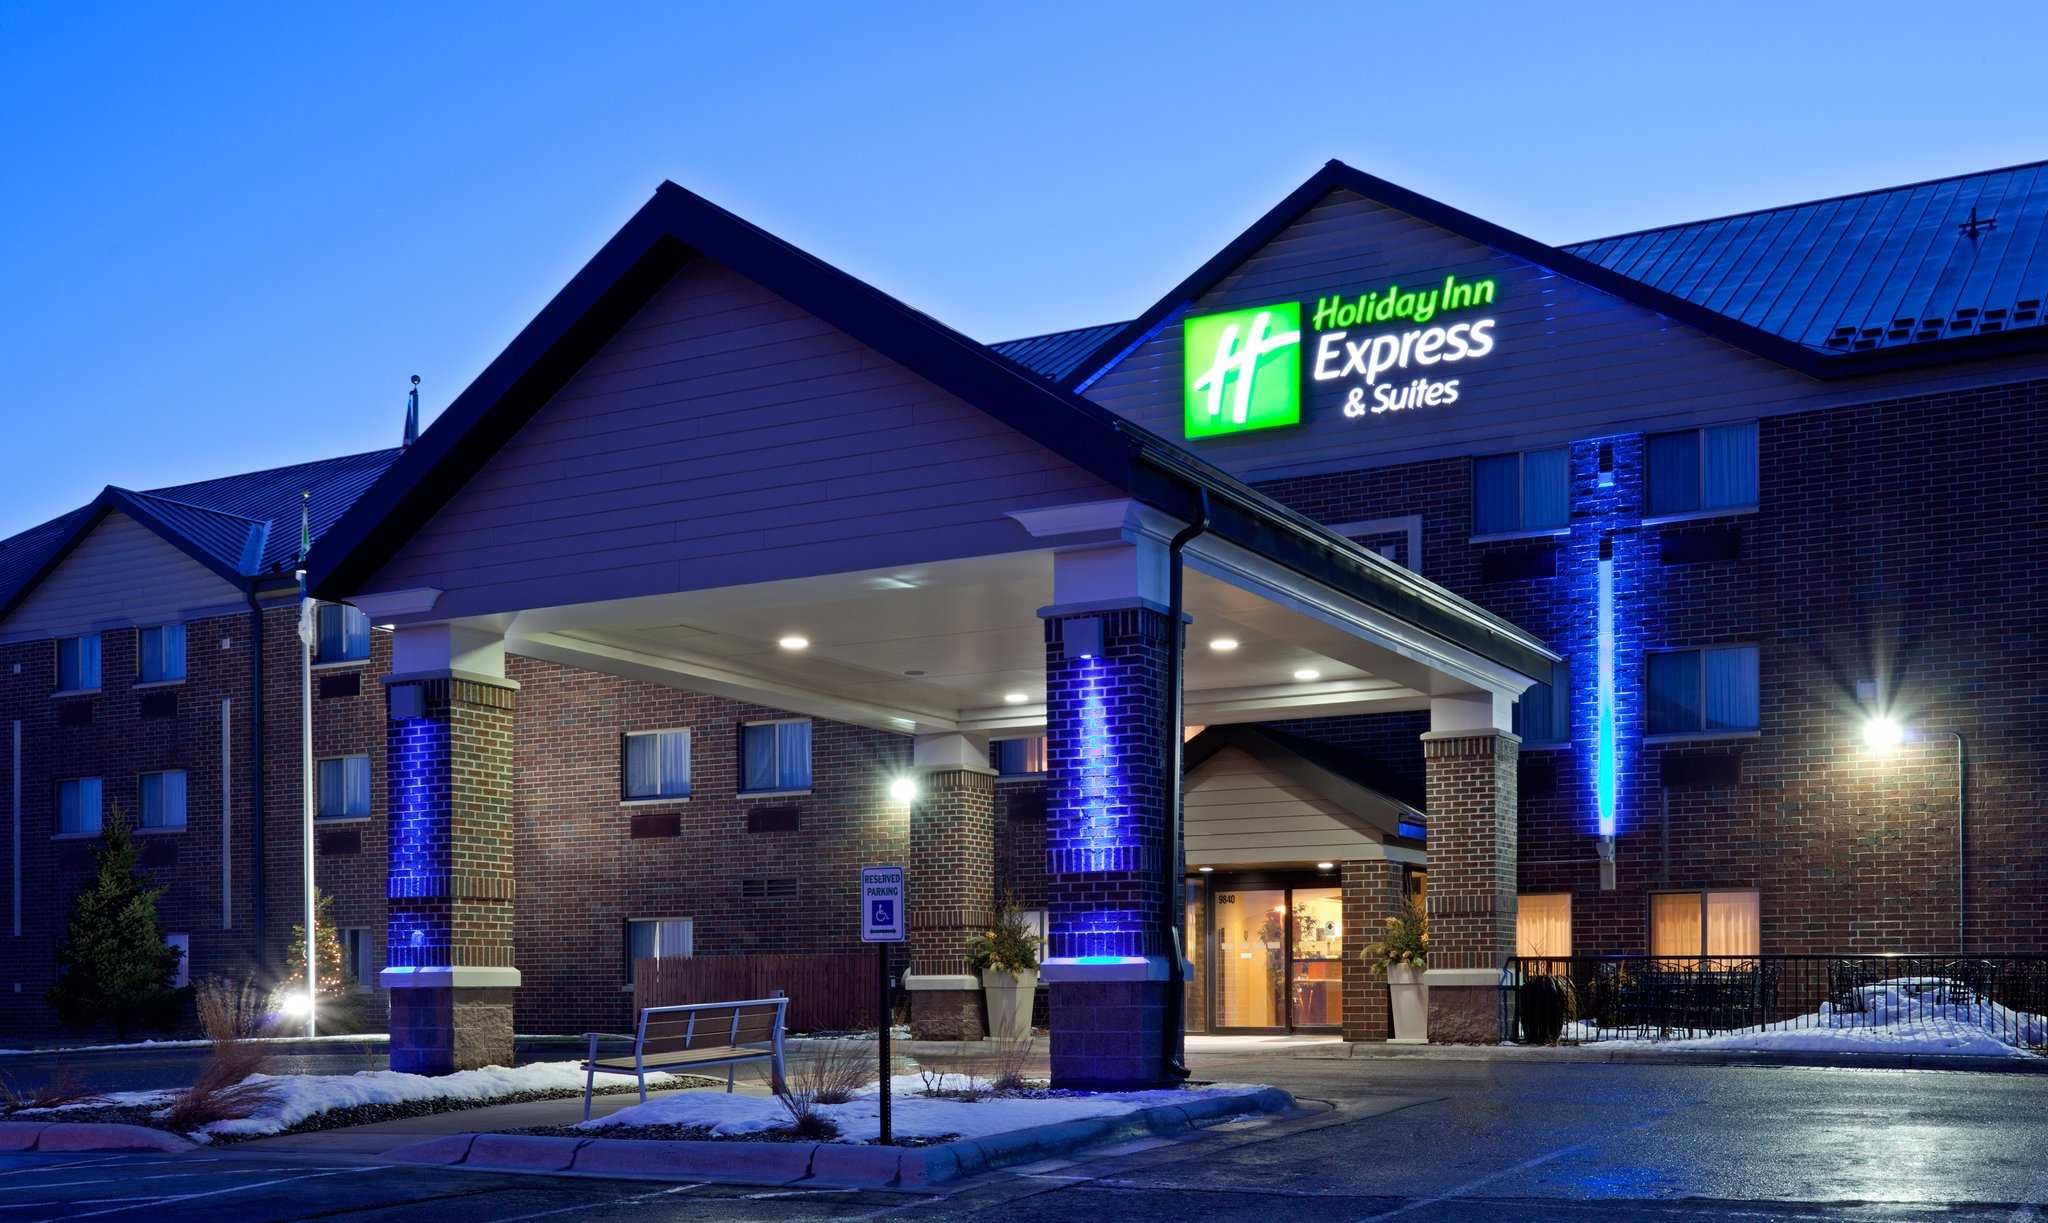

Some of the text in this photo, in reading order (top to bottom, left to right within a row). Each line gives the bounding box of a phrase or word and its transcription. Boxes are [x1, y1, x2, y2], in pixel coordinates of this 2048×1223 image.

[1313, 275, 1495, 329] Holiday Inn
[1314, 319, 1495, 384] Express
[1343, 378, 1459, 418] & Suites
[864, 874, 900, 884] RESERVED
[867, 887, 898, 896] PARKING
